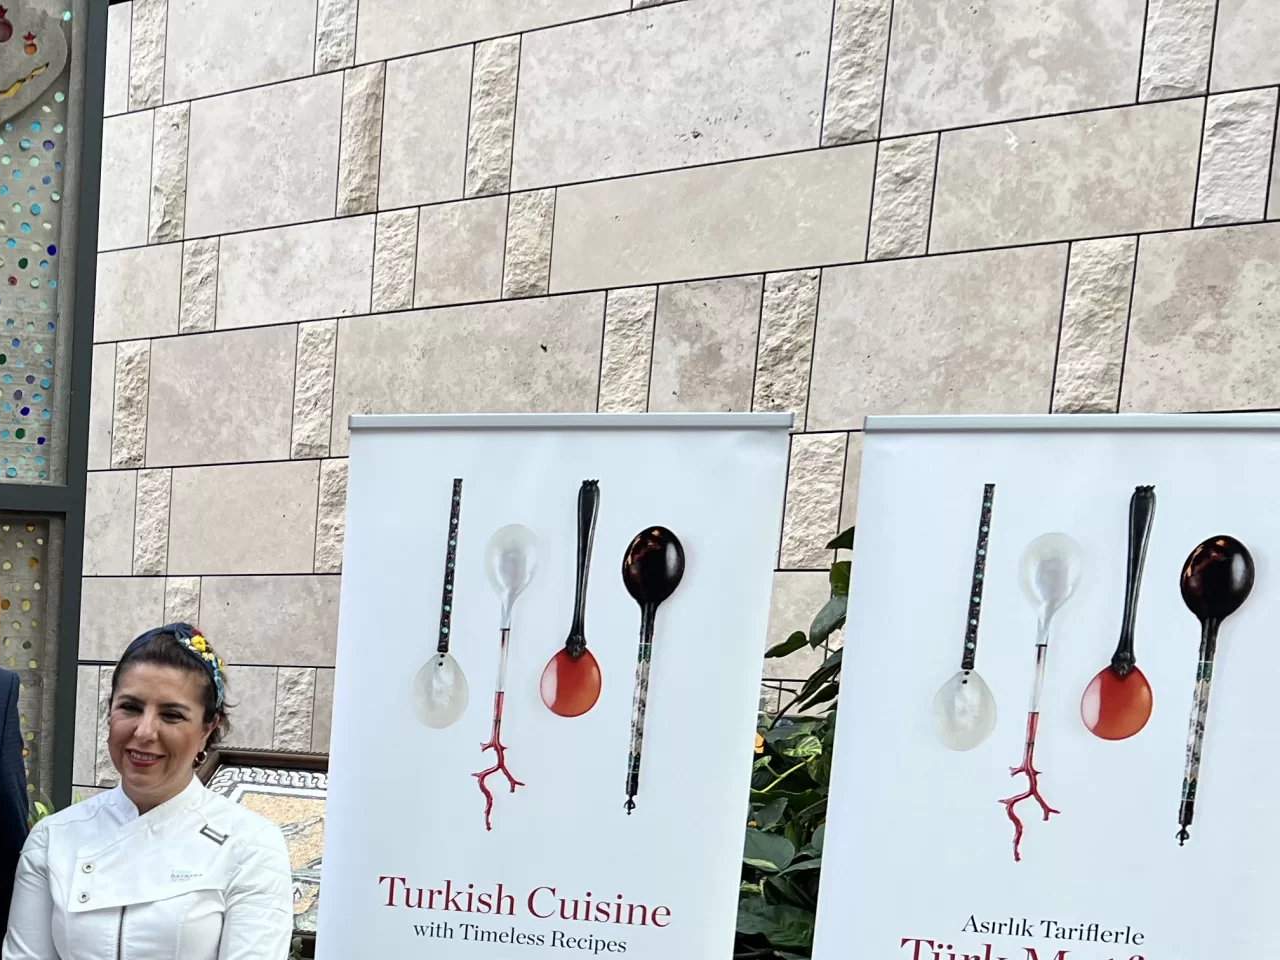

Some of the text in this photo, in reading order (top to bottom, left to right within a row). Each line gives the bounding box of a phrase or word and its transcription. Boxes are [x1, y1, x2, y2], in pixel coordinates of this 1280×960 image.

[379, 876, 671, 928] Turkish Cuisine
[413, 921, 627, 954] with Timeless Recipes
[961, 914, 1146, 946] Asırlık Tariflerle
